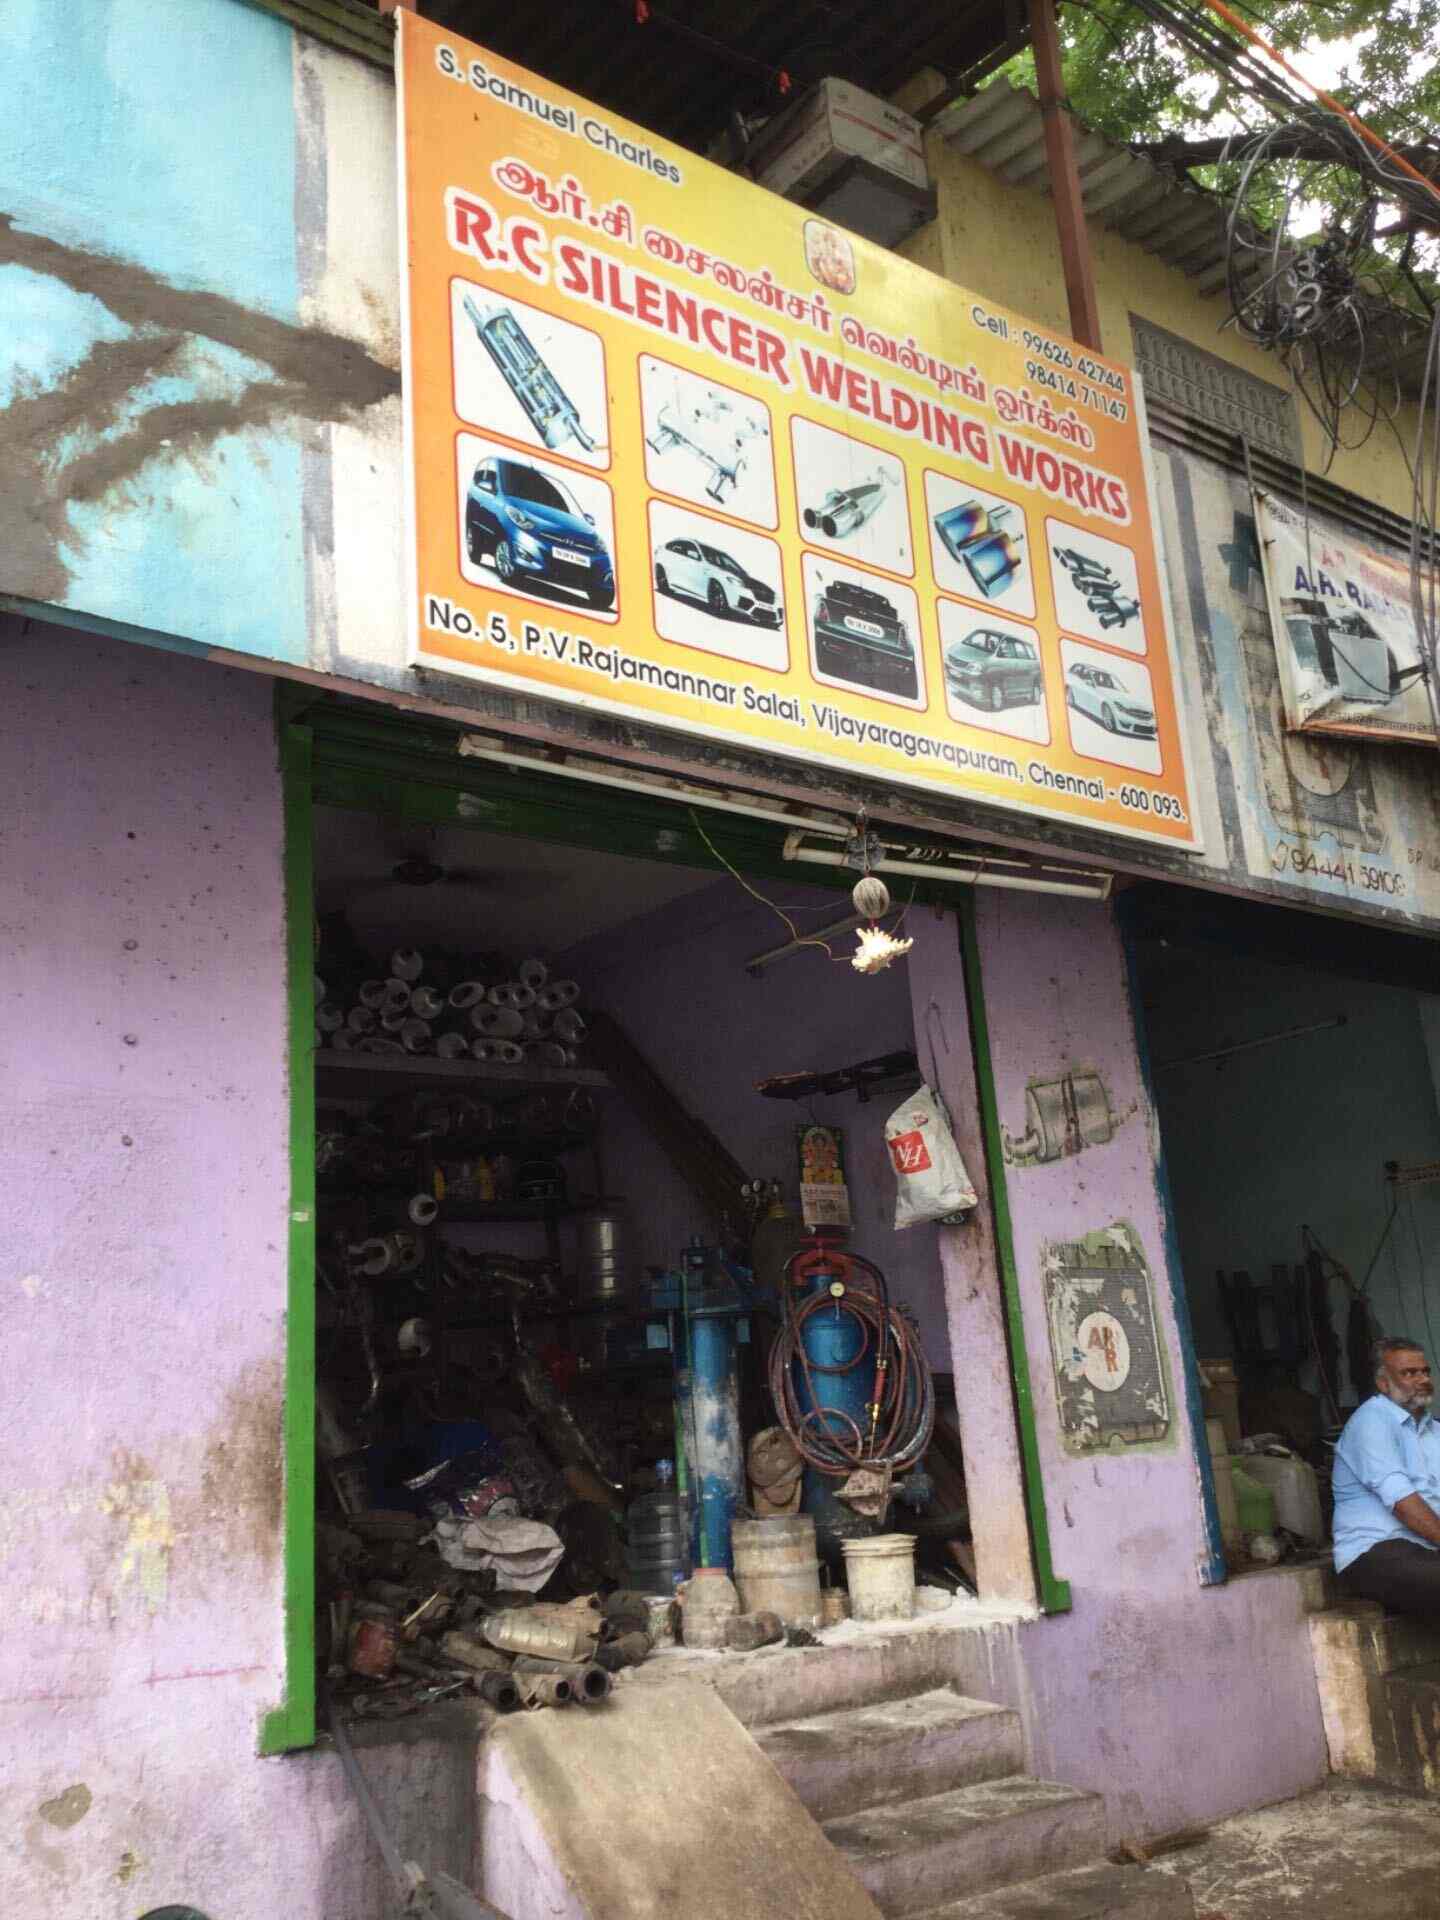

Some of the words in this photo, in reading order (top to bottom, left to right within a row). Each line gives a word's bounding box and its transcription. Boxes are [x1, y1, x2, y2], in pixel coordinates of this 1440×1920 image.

[439, 48, 462, 79] S.
[472, 63, 575, 132] Samuel
[584, 119, 680, 184] Charles
[496, 162, 632, 243] ஆர்.சி
[645, 229, 831, 331] சைலன்சர்
[453, 196, 542, 276] R.C
[559, 244, 790, 385] SILENCER
[800, 347, 989, 465] WELDING
[998, 435, 1127, 520] WORKS
[972, 306, 1008, 339] Cell
[1023, 330, 1073, 368] 99626
[1077, 357, 1124, 393] 42744
[1026, 361, 1077, 399] 98414
[1082, 386, 1127, 421] 71147
[429, 599, 480, 637] No.
[491, 615, 516, 650] 5,
[525, 624, 737, 705] P.V.Rajamannar
[744, 686, 806, 727] Salai,
[812, 706, 1024, 782] Vijayaragavapuram,
[1029, 763, 1105, 800] Chennai
[1120, 786, 1149, 811] 600
[1153, 794, 1186, 820] 093.
